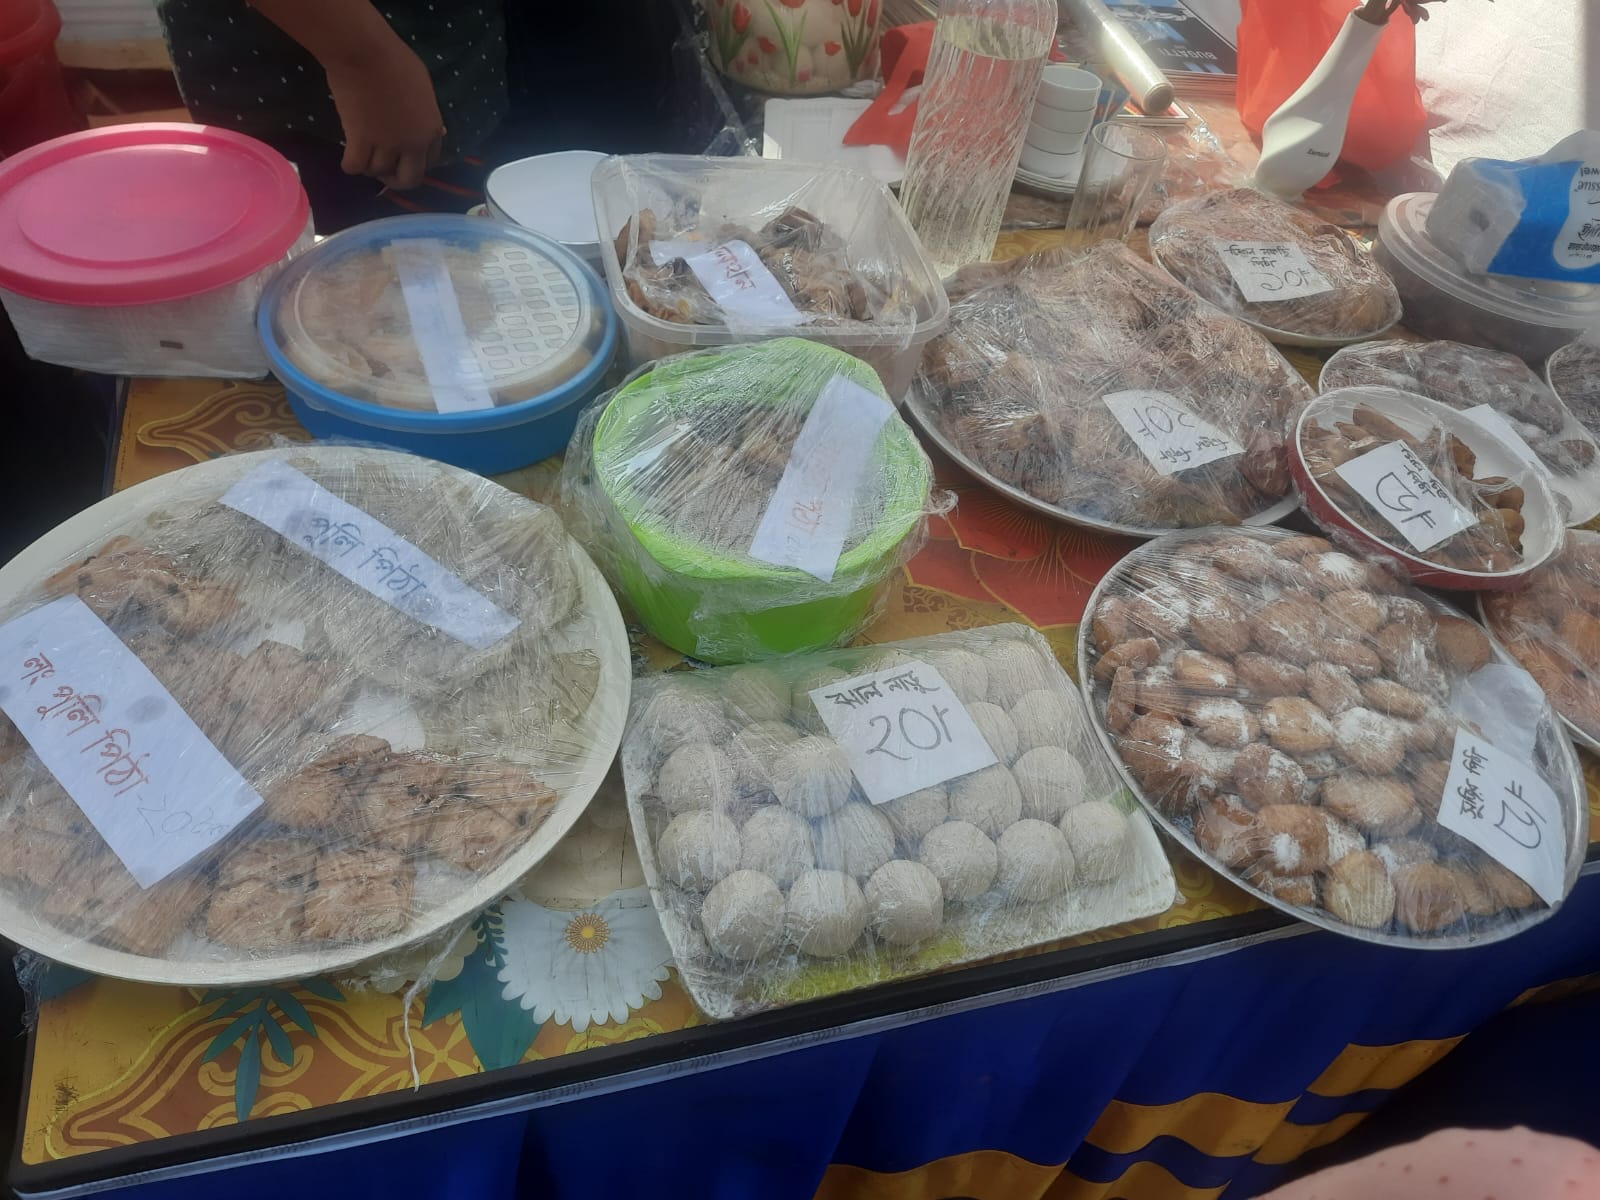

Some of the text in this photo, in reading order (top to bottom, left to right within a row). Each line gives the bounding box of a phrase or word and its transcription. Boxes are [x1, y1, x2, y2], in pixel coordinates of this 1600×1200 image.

[1159, 47, 1218, 60] BUGATTI
[302, 516, 426, 599] পুলি পিঠা
[37, 685, 104, 737] পুলি
[80, 728, 152, 798] পিঠা
